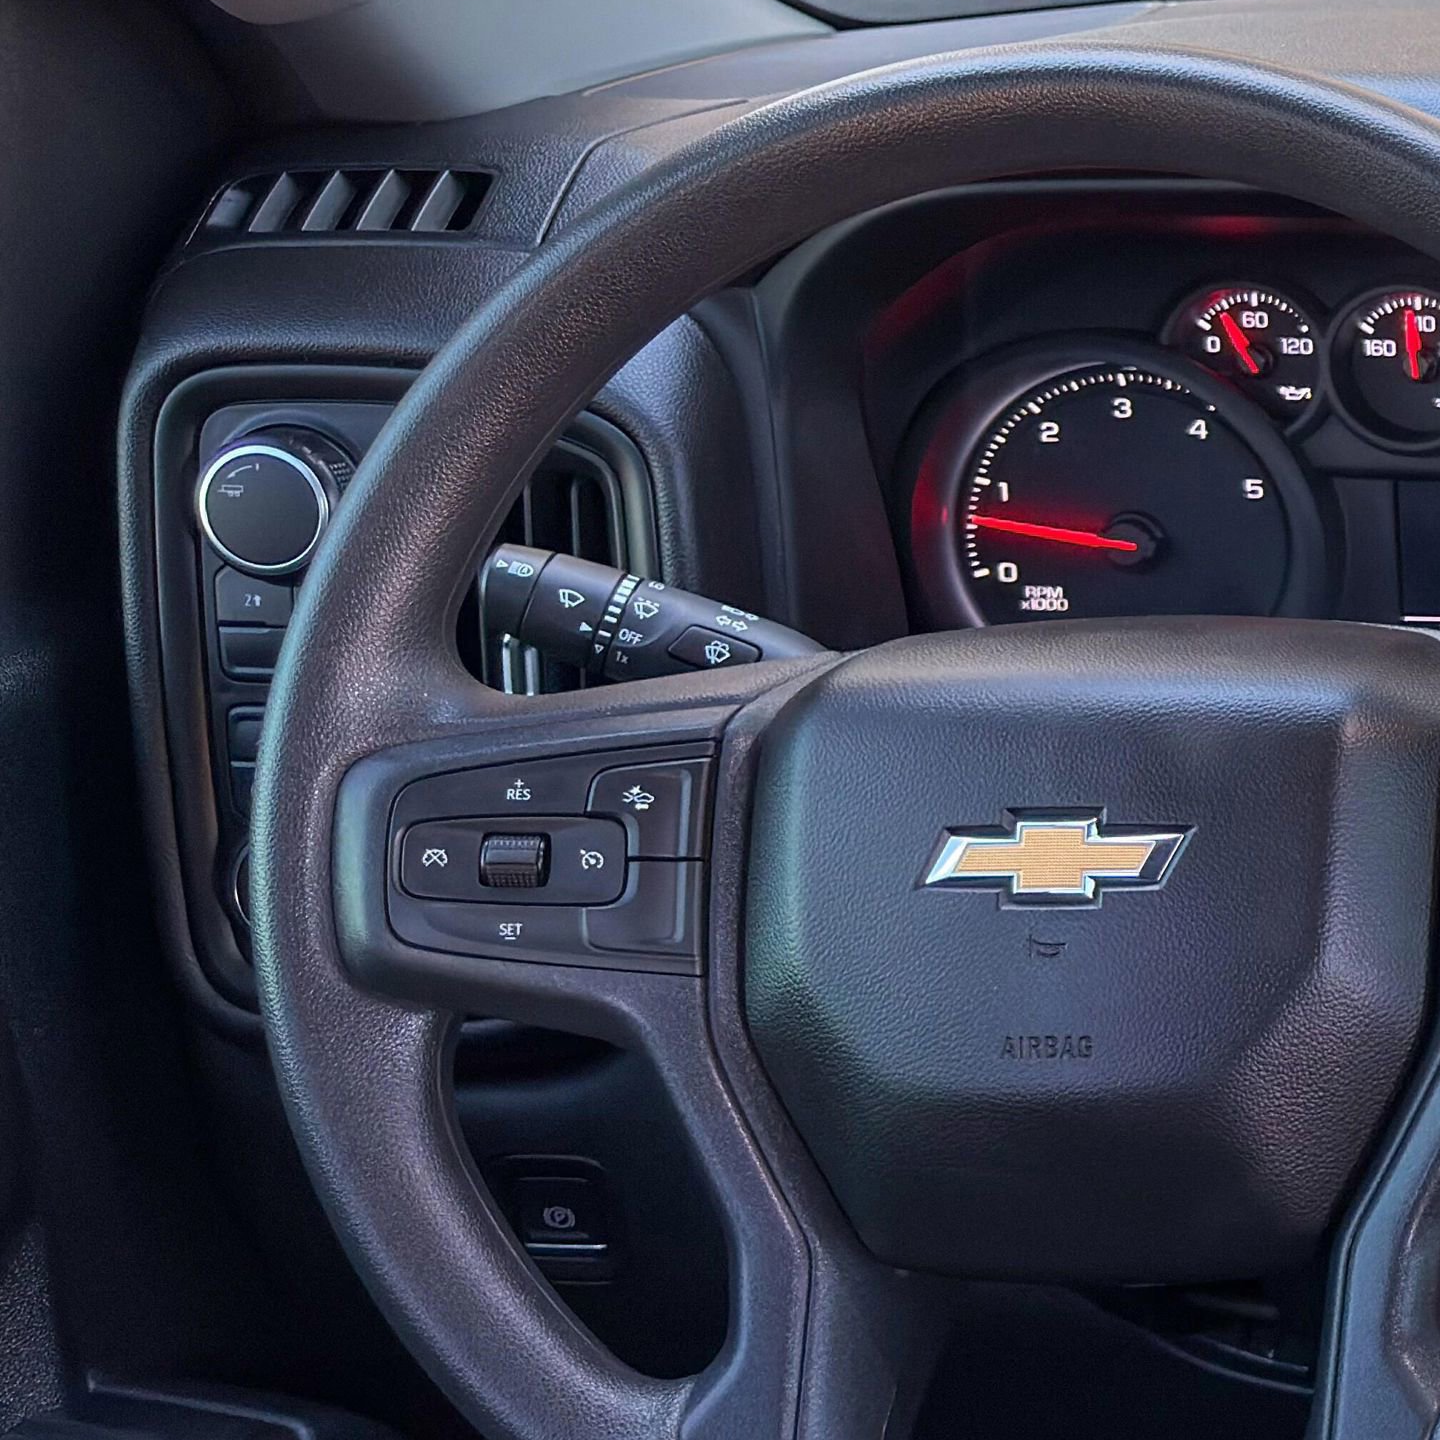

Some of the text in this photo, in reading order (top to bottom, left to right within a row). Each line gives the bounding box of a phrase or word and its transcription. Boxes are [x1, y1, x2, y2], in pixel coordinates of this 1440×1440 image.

[1242, 313, 1268, 329] 60
[1206, 338, 1221, 354] 0
[1281, 338, 1314, 356] 120
[1363, 338, 1397, 357] 160
[1113, 397, 1132, 419] 3
[1039, 421, 1060, 444] 2
[1186, 418, 1209, 440] 4
[998, 480, 1009, 502] 1
[1242, 478, 1264, 500] 5
[997, 561, 1018, 583] 0
[1024, 585, 1064, 599] RPM
[1020, 598, 1069, 611] x1000
[618, 628, 644, 646] OFF
[615, 651, 628, 664] 1x
[506, 788, 531, 801] RES
[499, 923, 523, 936] SET
[1001, 1034, 1095, 1059] AIRBAG
